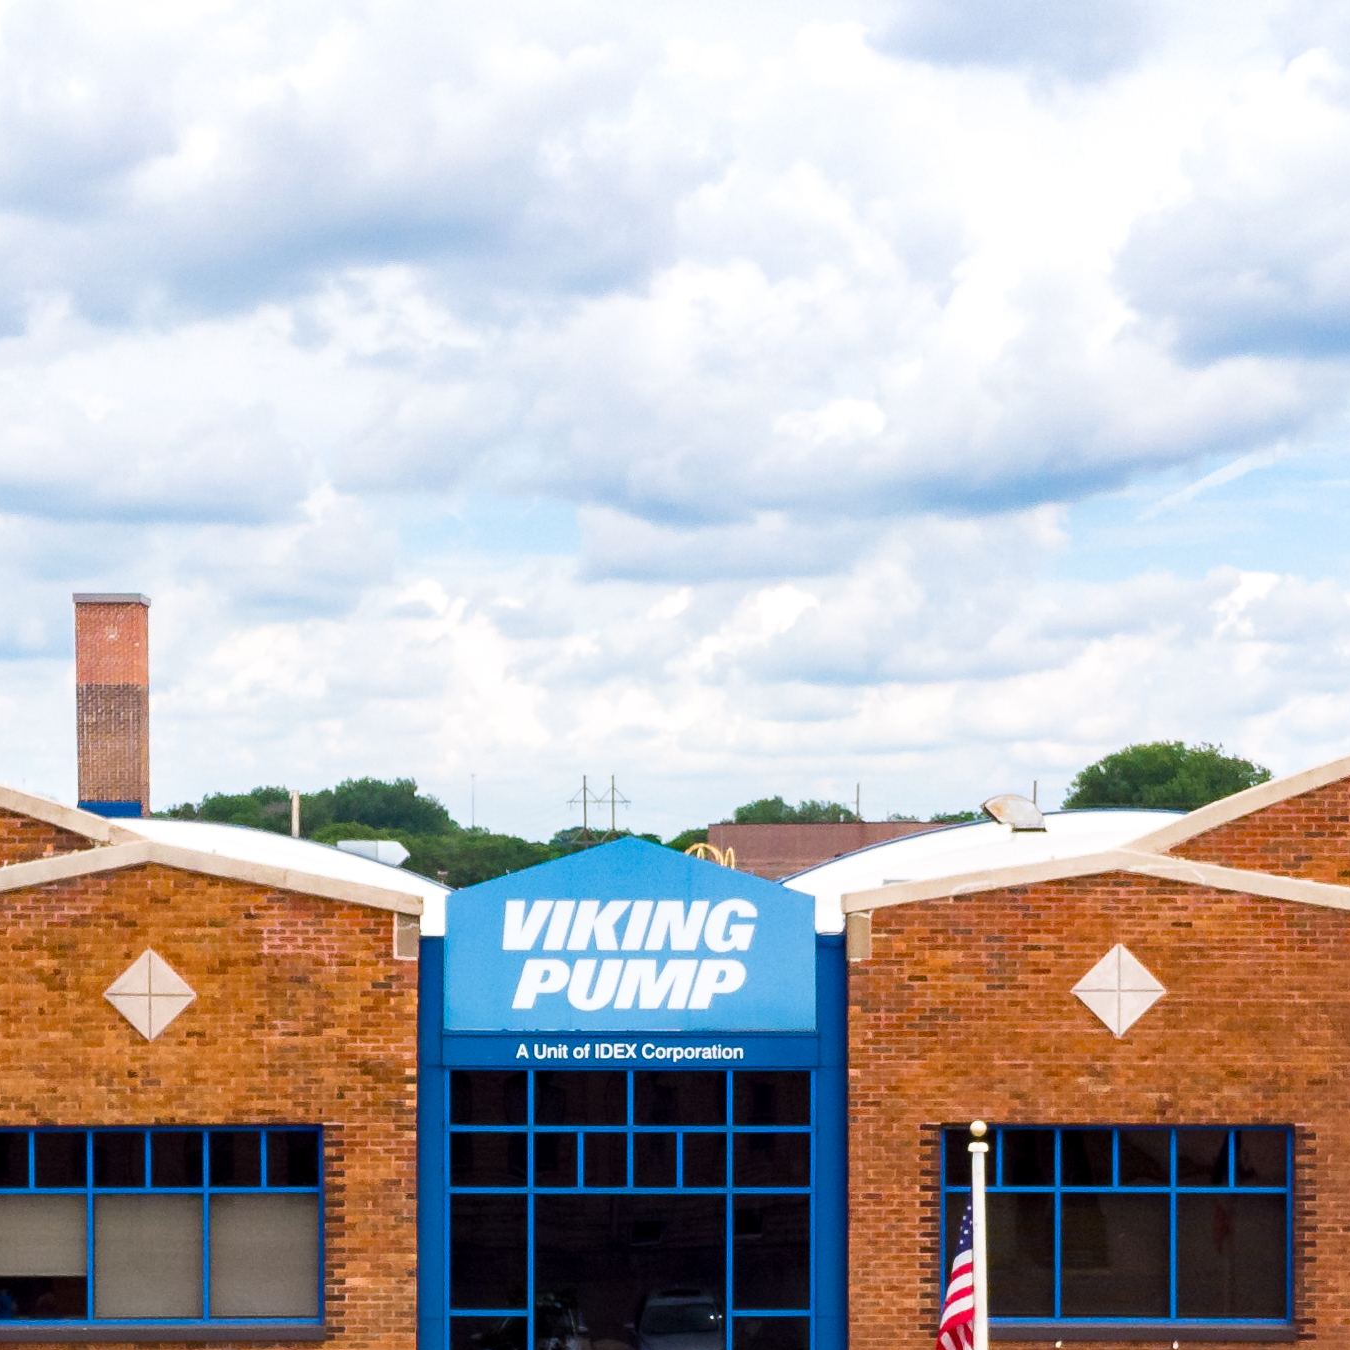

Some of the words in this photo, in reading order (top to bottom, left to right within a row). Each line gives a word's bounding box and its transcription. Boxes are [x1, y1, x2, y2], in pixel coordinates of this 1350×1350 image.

[501, 897, 759, 954] VIKING
[511, 958, 747, 1012] PUMP
[515, 1043, 529, 1059] A
[533, 1043, 569, 1060] Unit
[572, 1043, 591, 1060] of
[594, 1043, 638, 1060] IDEX
[641, 1042, 744, 1063] Corporation
